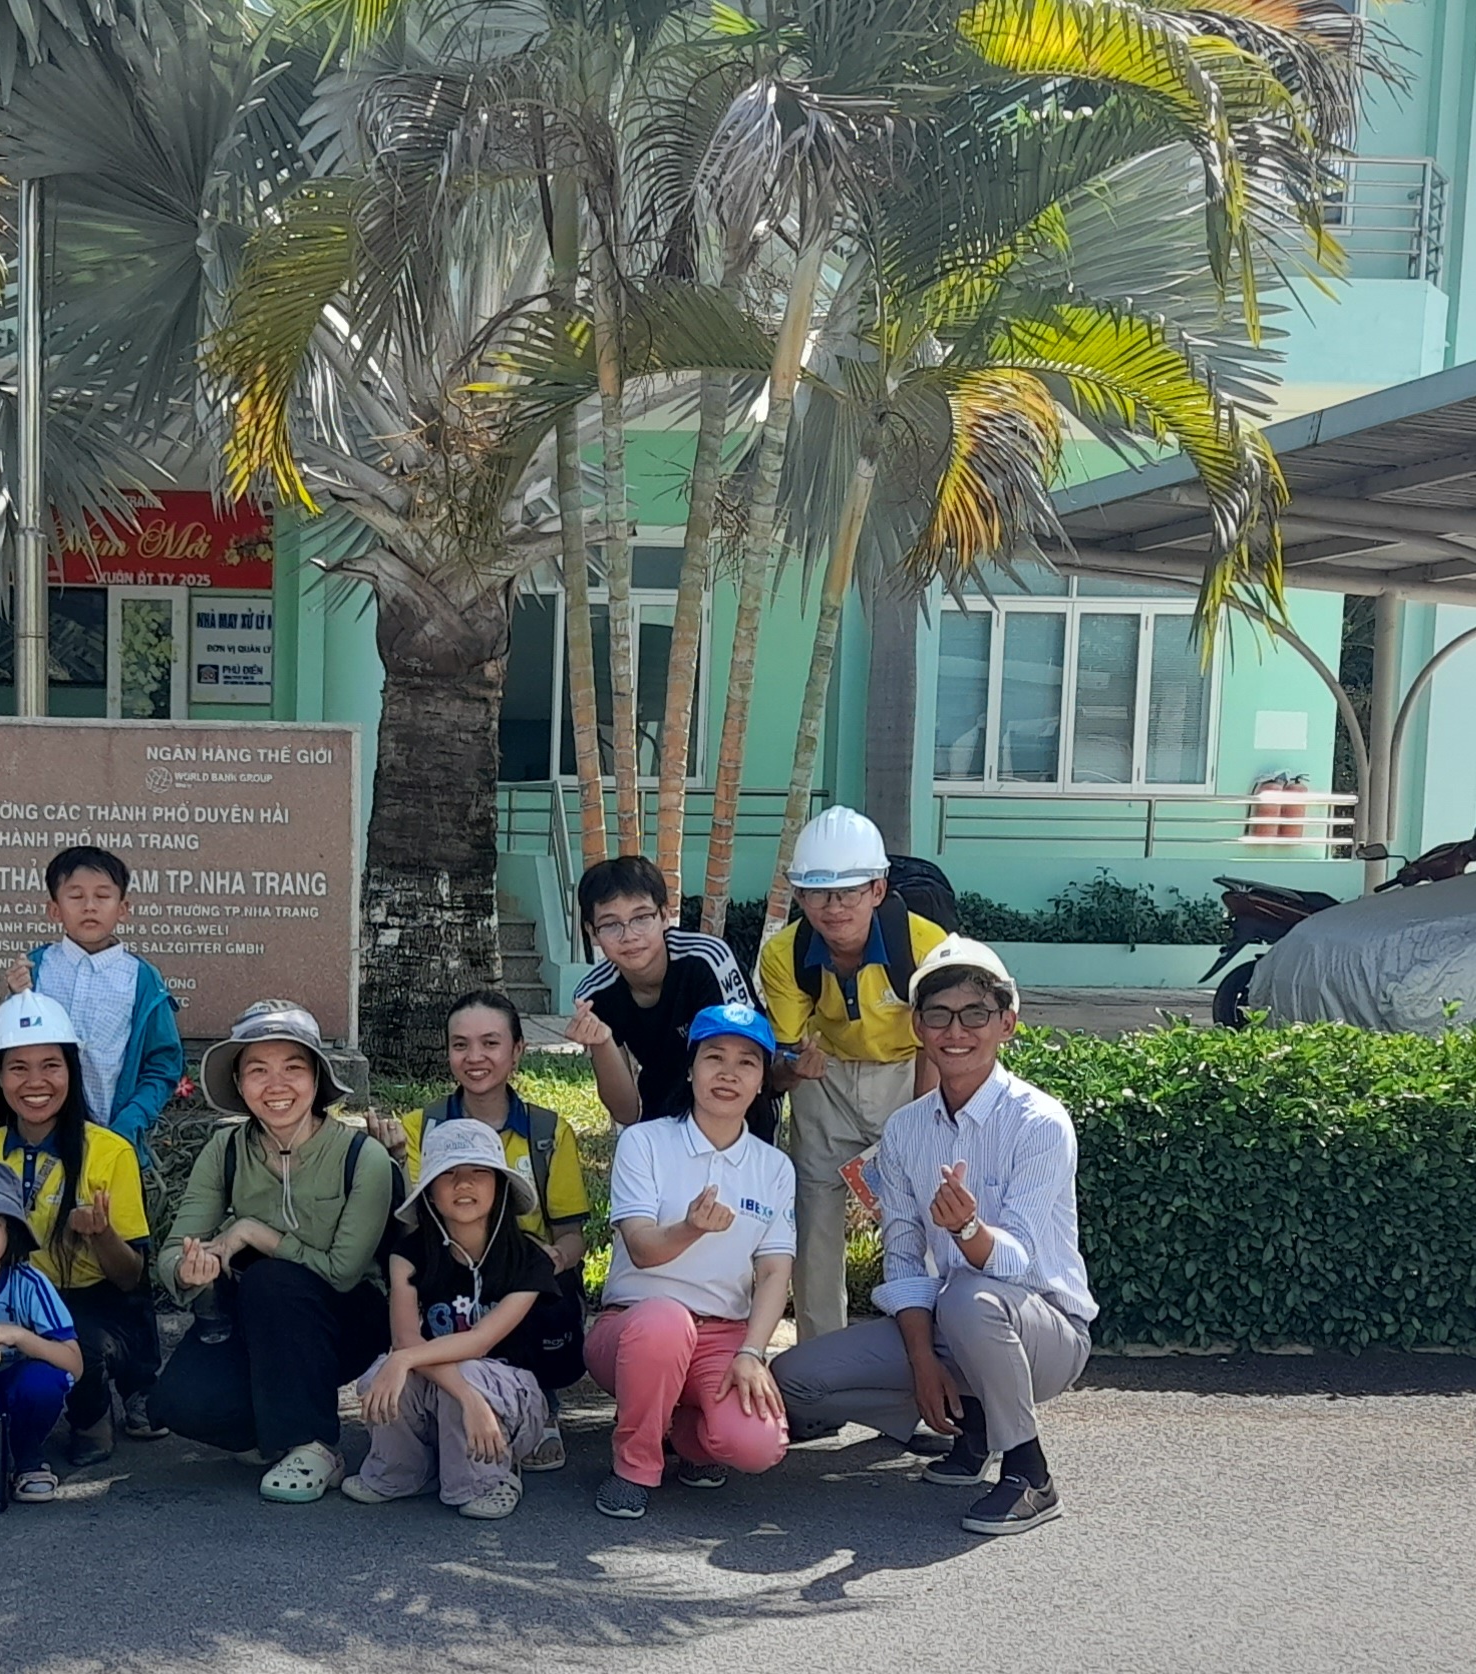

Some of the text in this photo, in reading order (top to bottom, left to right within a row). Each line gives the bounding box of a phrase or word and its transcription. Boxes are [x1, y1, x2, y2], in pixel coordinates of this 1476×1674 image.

[179, 573, 212, 587] 2025
[145, 743, 333, 765] NGÂN HÀNG THẾ GIỚI
[174, 771, 273, 784] WORLD BANK GROUP
[43, 801, 81, 821] CÁC
[86, 801, 147, 822] THÀNH
[152, 800, 190, 822] PHỐ
[195, 804, 255, 824] DUYÊN
[259, 802, 290, 824] HẢI
[53, 825, 92, 848] PHỐ
[96, 831, 134, 850] NHA
[138, 832, 200, 851] TRANG
[127, 870, 160, 895] AM
[165, 869, 246, 895] TP.NHA
[251, 871, 328, 897] TRANG
[138, 904, 163, 917] MÔI
[166, 903, 221, 918] TRƯỜNG
[224, 905, 272, 918] TP.NHA
[276, 906, 320, 919] TRANG
[26, 922, 65, 934] FICHT
[138, 925, 147, 936] &
[141, 942, 223, 954] SALZGITTER
[225, 943, 265, 955] GMBH
